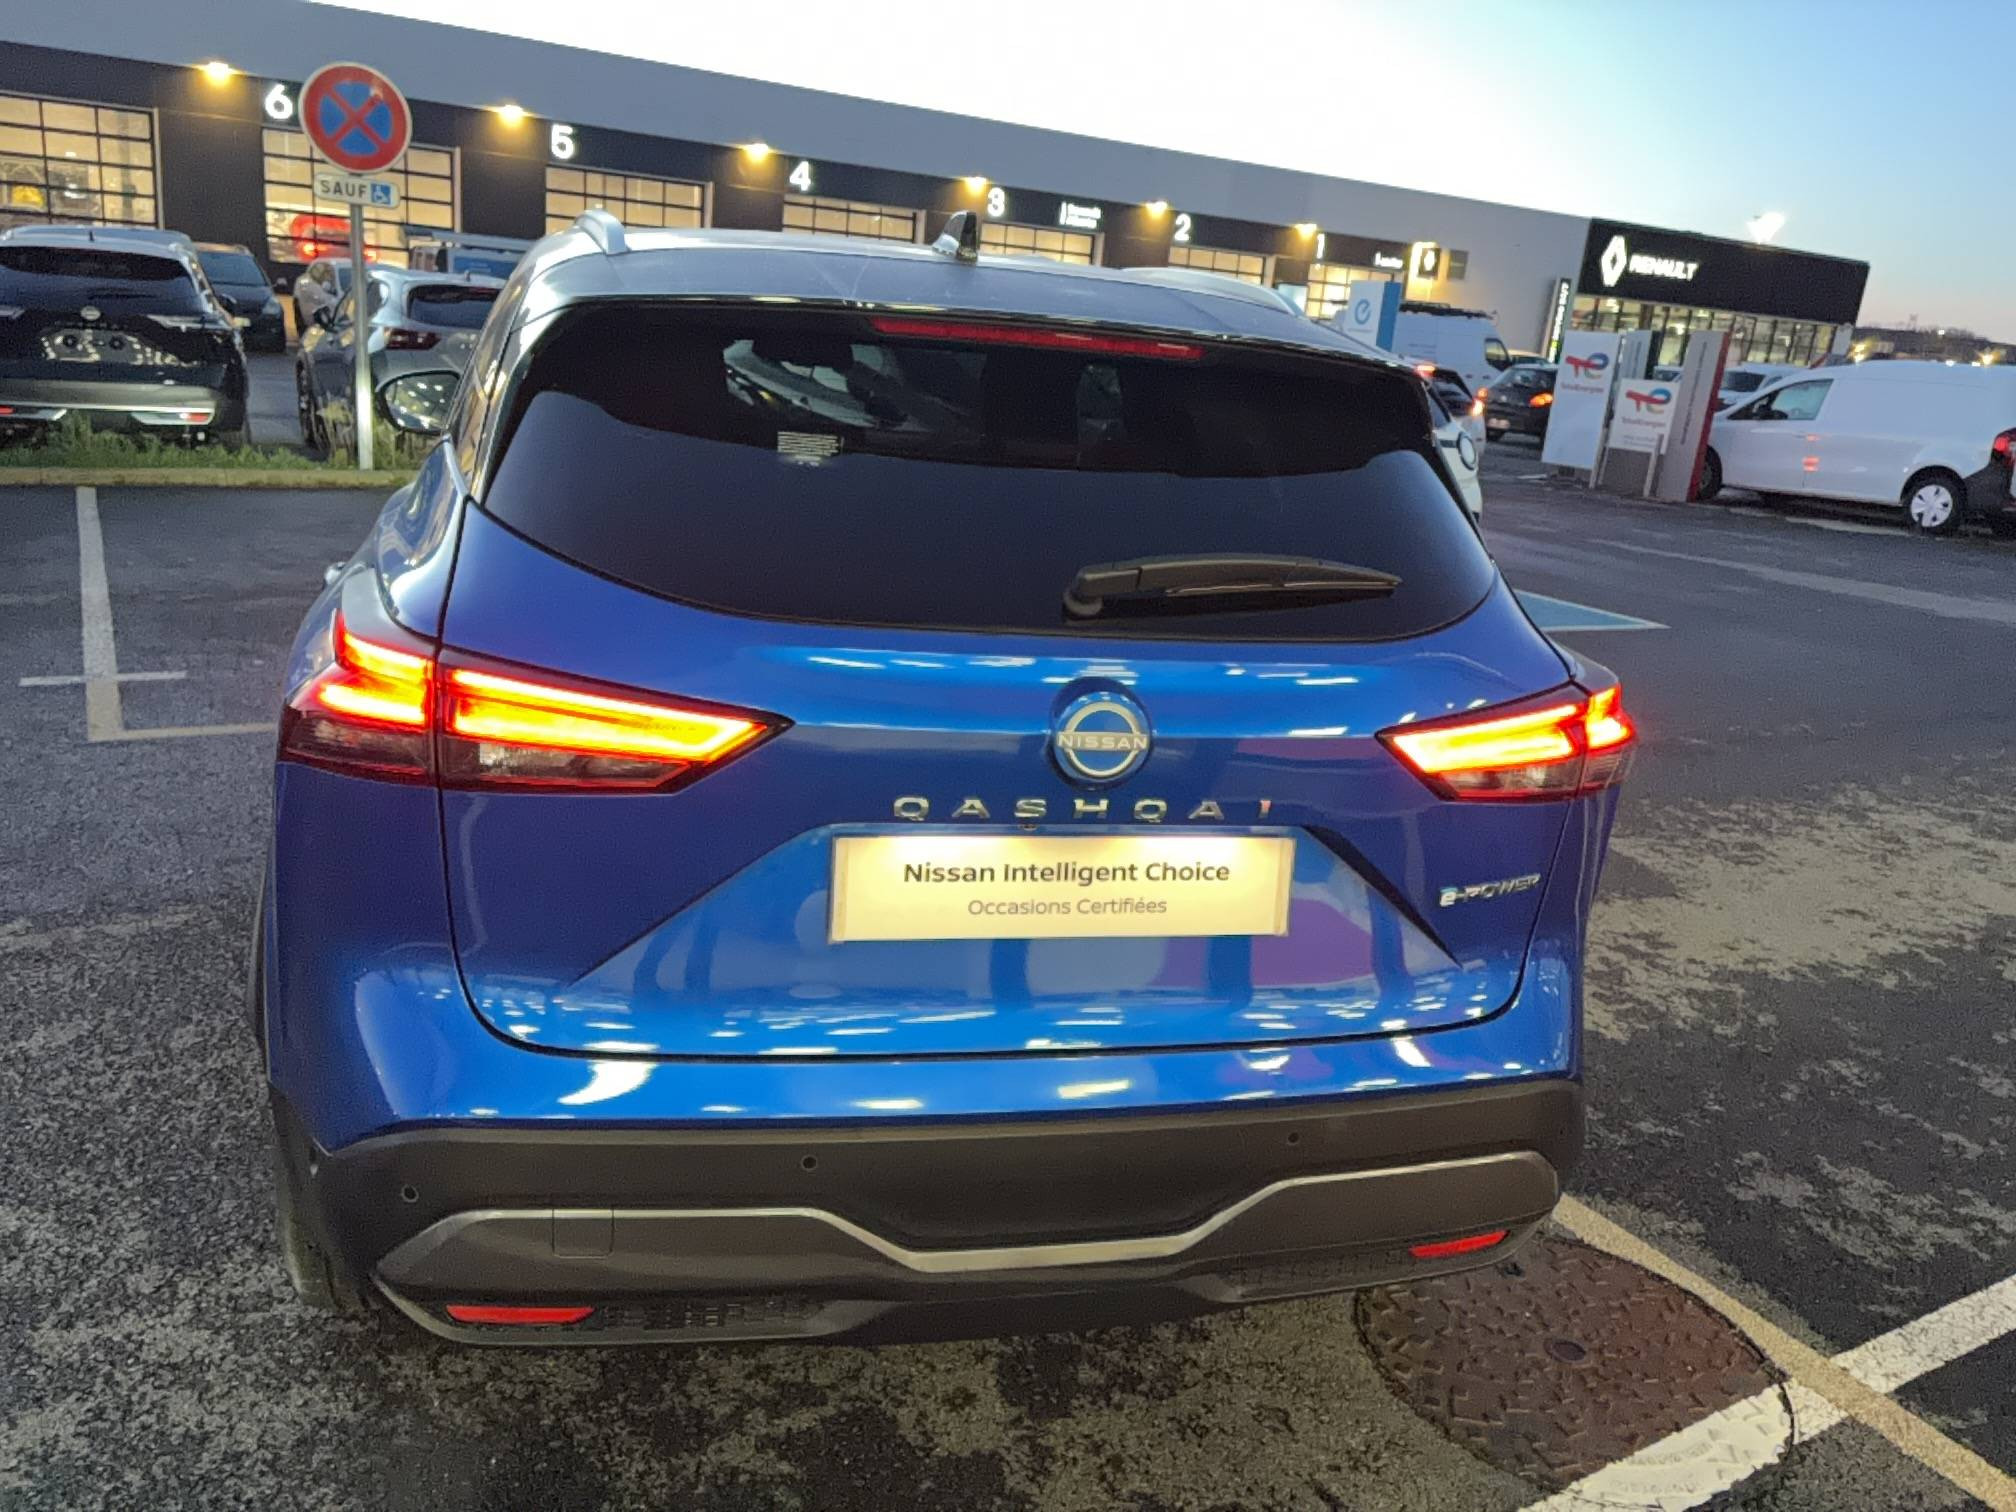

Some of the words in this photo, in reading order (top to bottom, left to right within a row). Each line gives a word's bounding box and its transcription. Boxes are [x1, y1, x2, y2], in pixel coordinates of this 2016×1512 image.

[264, 83, 294, 120] 6
[551, 124, 576, 159] 5
[320, 179, 368, 199] SAUF
[789, 160, 812, 191] 4
[987, 186, 1006, 217] 3
[1174, 213, 1192, 242] 2
[1629, 254, 1698, 281] RENAULT
[1056, 732, 1149, 751] NISSAN
[893, 796, 1272, 823] QASHQAI
[903, 862, 995, 883] Nissan
[1003, 861, 1138, 886] Intelligent
[1145, 861, 1231, 882] Choice
[1440, 873, 1541, 907] e-POWER
[967, 898, 1072, 915] Occasions
[1076, 896, 1168, 915] Certifiées
